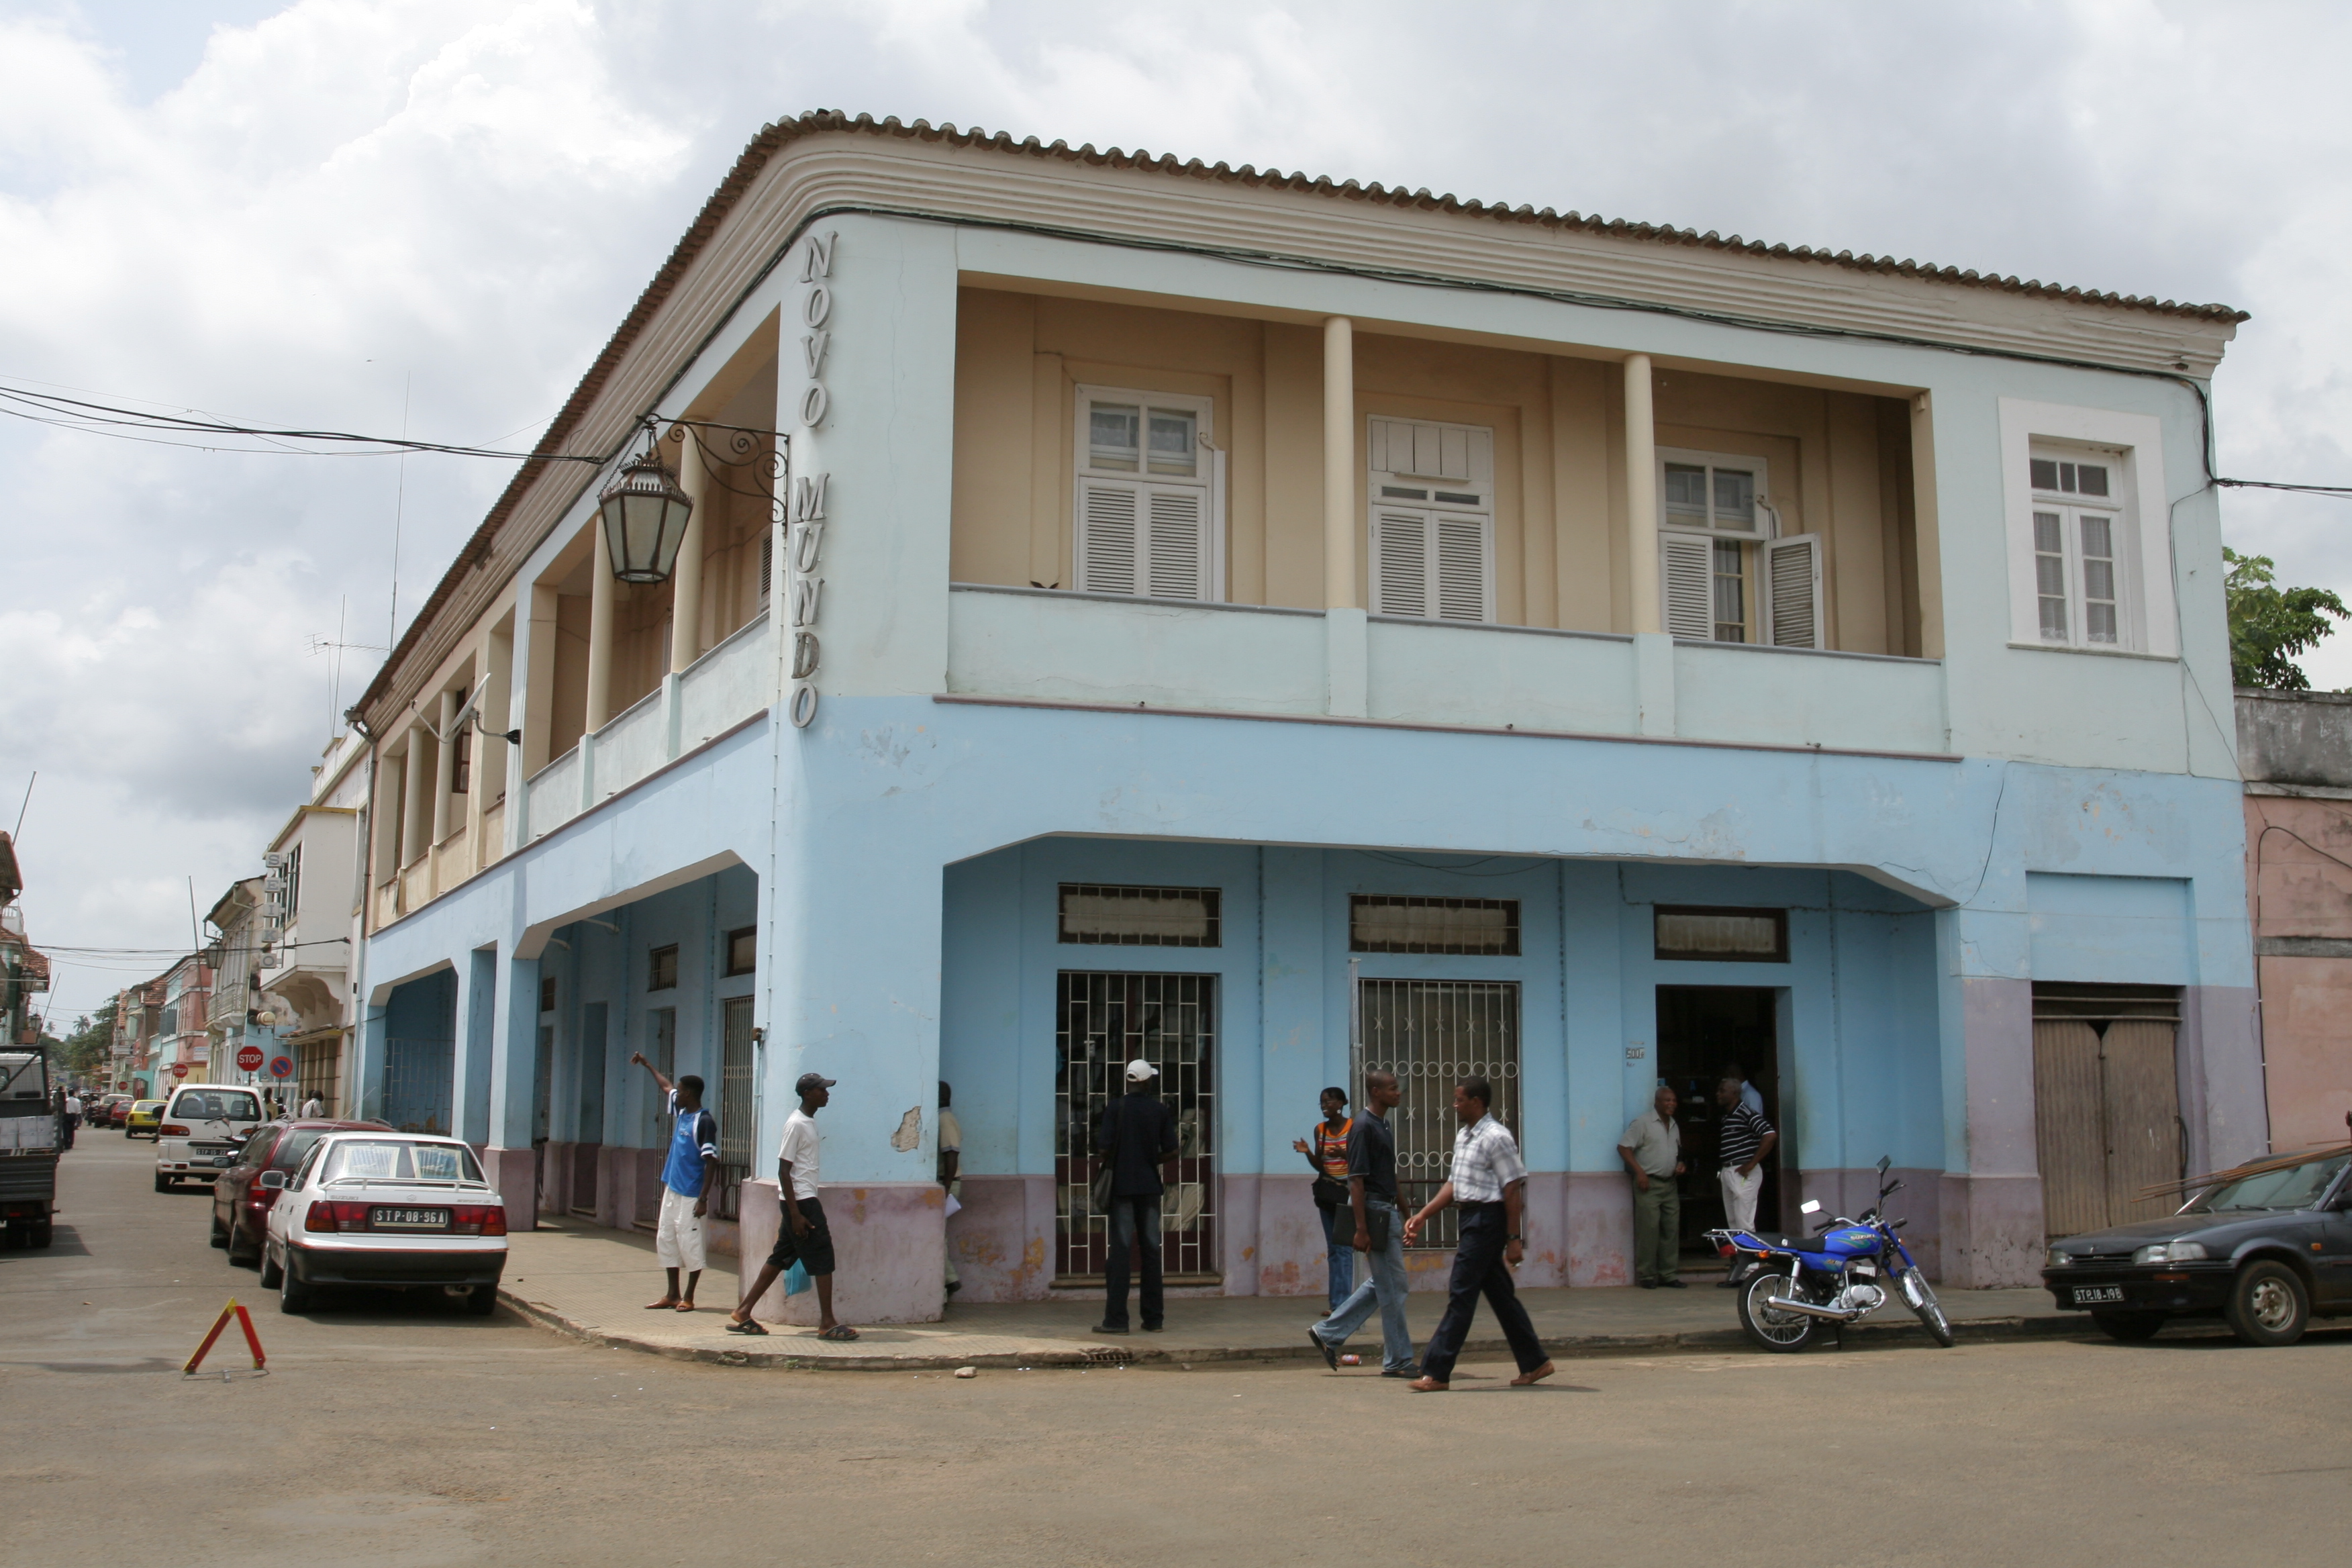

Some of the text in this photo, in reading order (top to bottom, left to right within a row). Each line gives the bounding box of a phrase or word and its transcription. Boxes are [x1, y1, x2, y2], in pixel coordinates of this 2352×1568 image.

[789, 230, 838, 729] NOVO MUNDO
[262, 854, 280, 967] SEIKO
[238, 1054, 262, 1064] STOP
